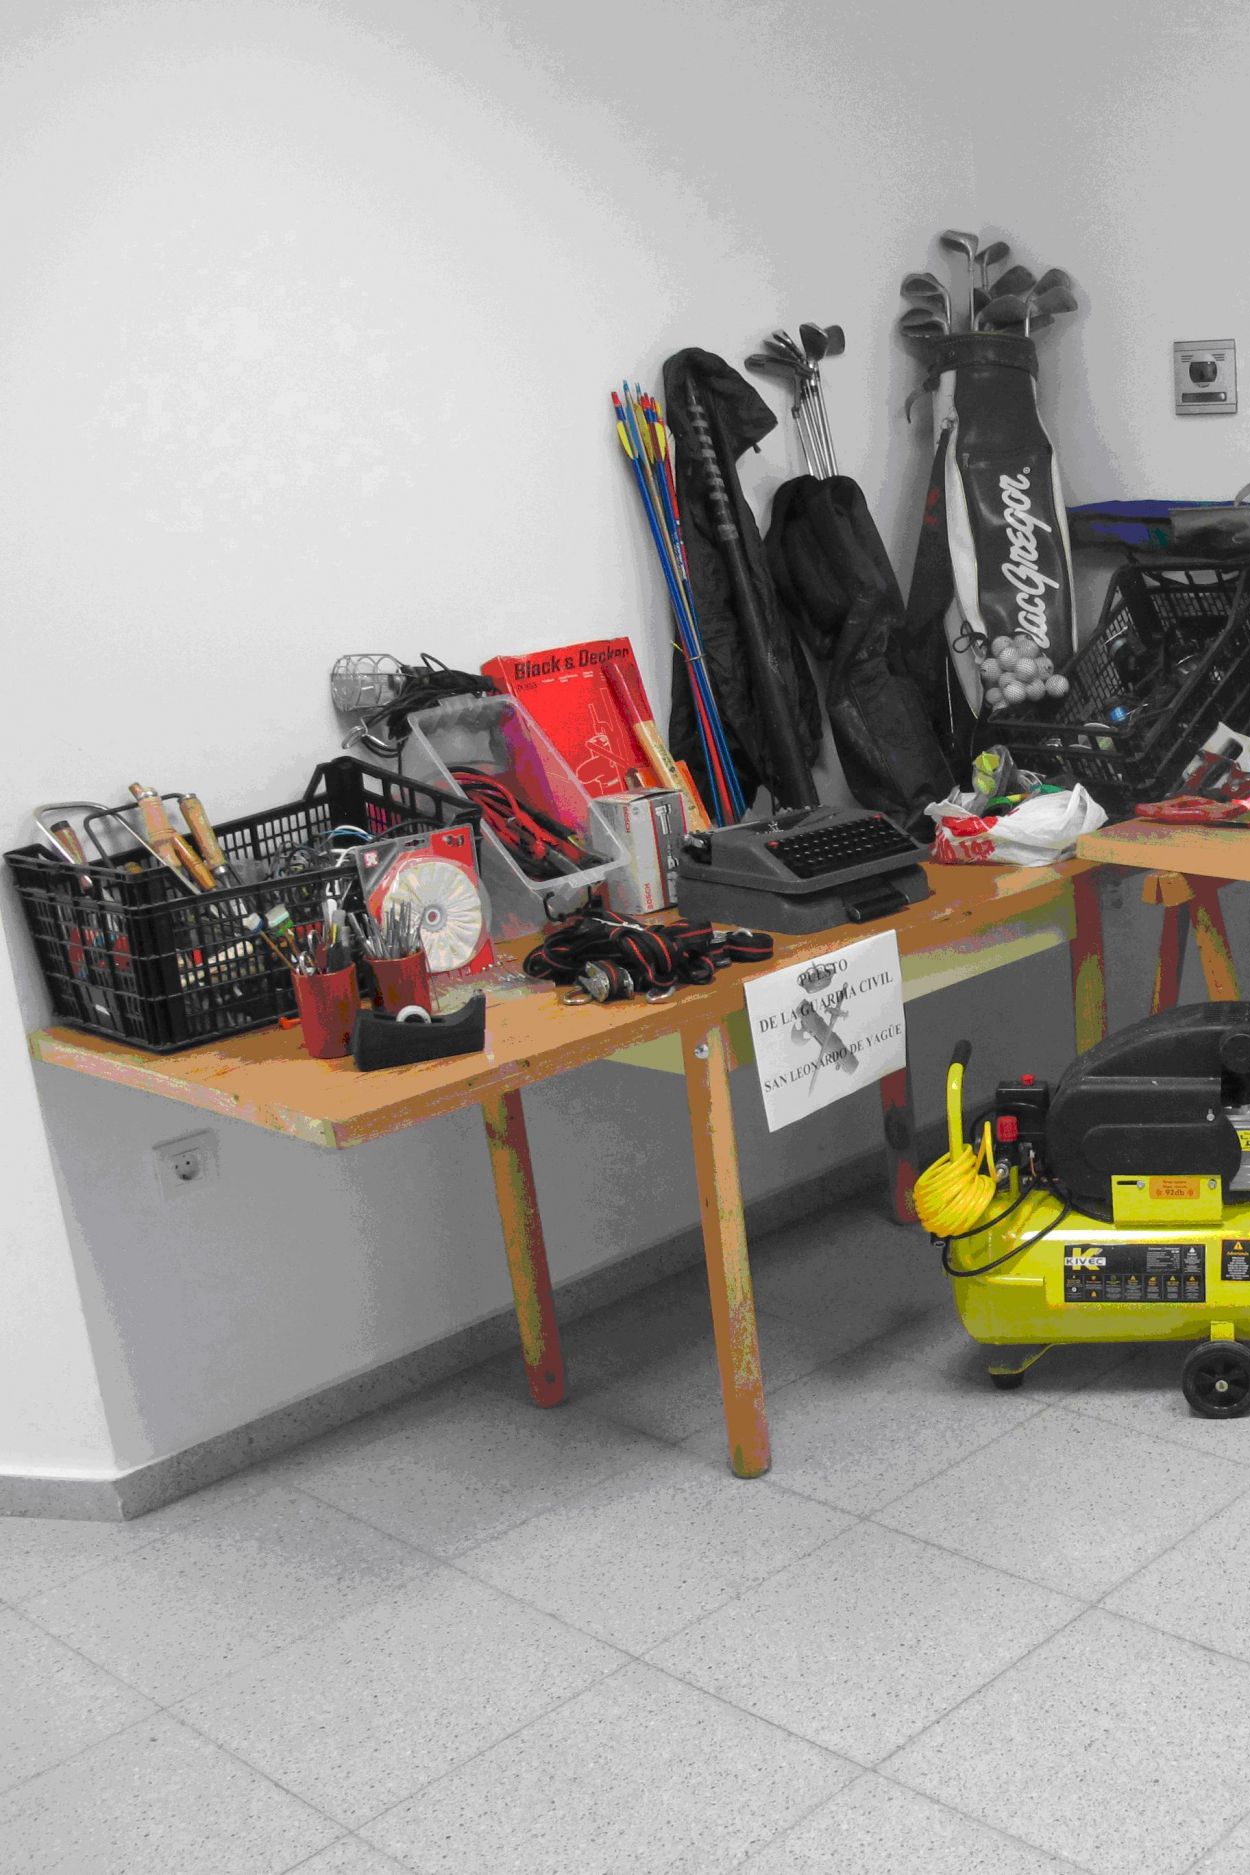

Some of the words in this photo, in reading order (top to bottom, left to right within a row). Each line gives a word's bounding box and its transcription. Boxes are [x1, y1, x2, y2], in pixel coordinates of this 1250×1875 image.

[514, 656, 561, 681] Black
[565, 656, 575, 670] &
[578, 645, 630, 668] Decker
[644, 882, 654, 910] BOSCH
[799, 958, 848, 986] PUESTO
[759, 1015, 777, 1033] DE
[781, 1008, 798, 1025] LA
[800, 984, 857, 1017] GUARDIA
[859, 971, 893, 993] CIVIL
[764, 1074, 788, 1093] SAN
[790, 1048, 847, 1082] LEONARDO
[850, 1039, 864, 1055] DE
[866, 1023, 903, 1048] YAGÜE
[1065, 1258, 1105, 1266] KIVEC
